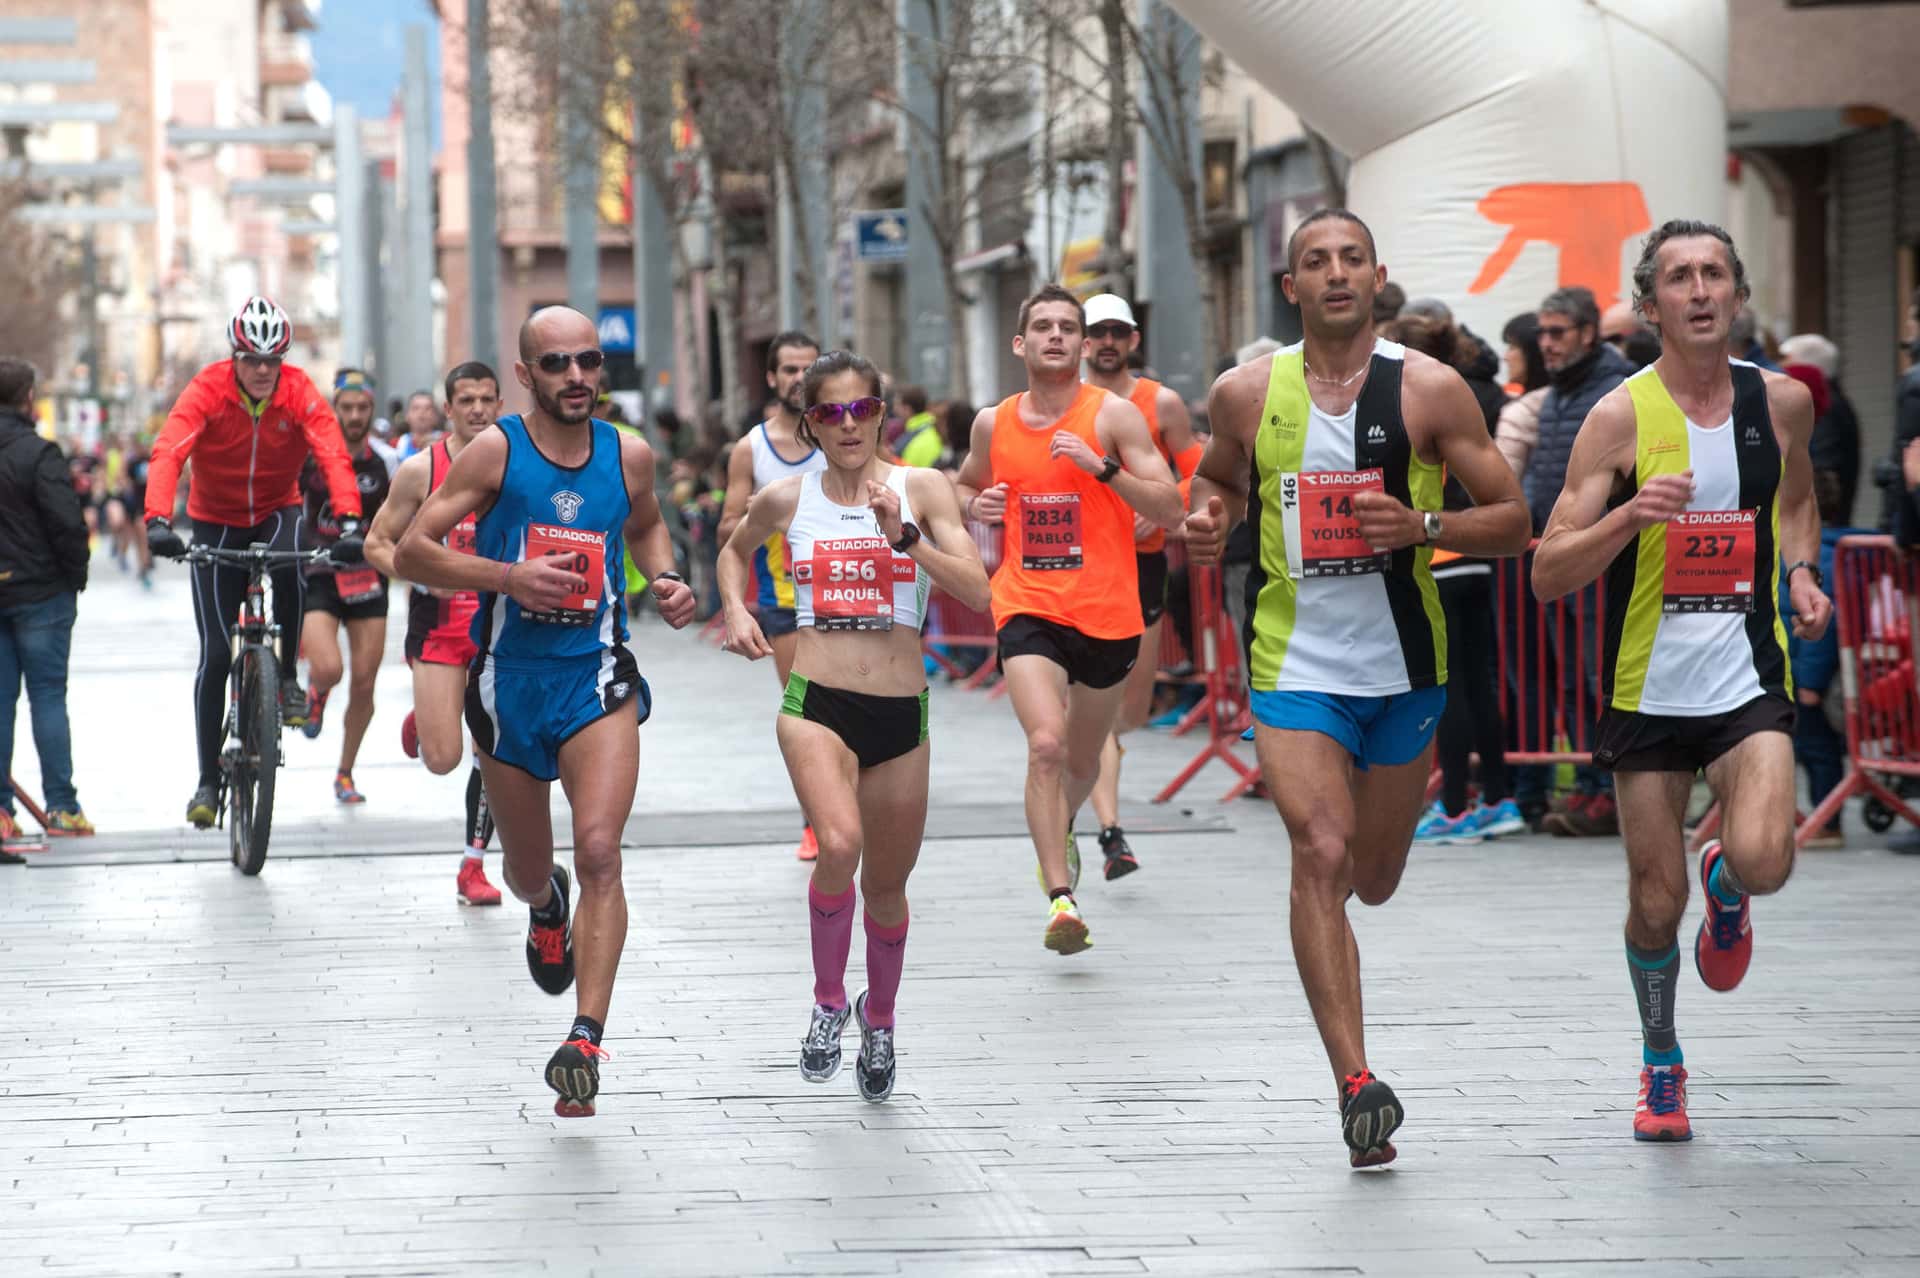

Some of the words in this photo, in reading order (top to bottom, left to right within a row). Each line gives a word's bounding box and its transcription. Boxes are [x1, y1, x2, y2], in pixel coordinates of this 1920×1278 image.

[1319, 471, 1381, 485] DIADORA
[1031, 495, 1080, 504] DIADORA
[1283, 478, 1297, 509] 146
[1319, 495, 1353, 519] 14
[1026, 509, 1073, 526] 2834
[1688, 512, 1754, 524] DIADORA
[548, 528, 603, 545] DIADORA
[1027, 532, 1075, 544] PABLO
[1311, 527, 1364, 541] YOUSS
[832, 540, 890, 551] DIADORA
[1684, 535, 1737, 558] 237
[828, 559, 877, 582] 356
[823, 588, 884, 603] RAQUEL
